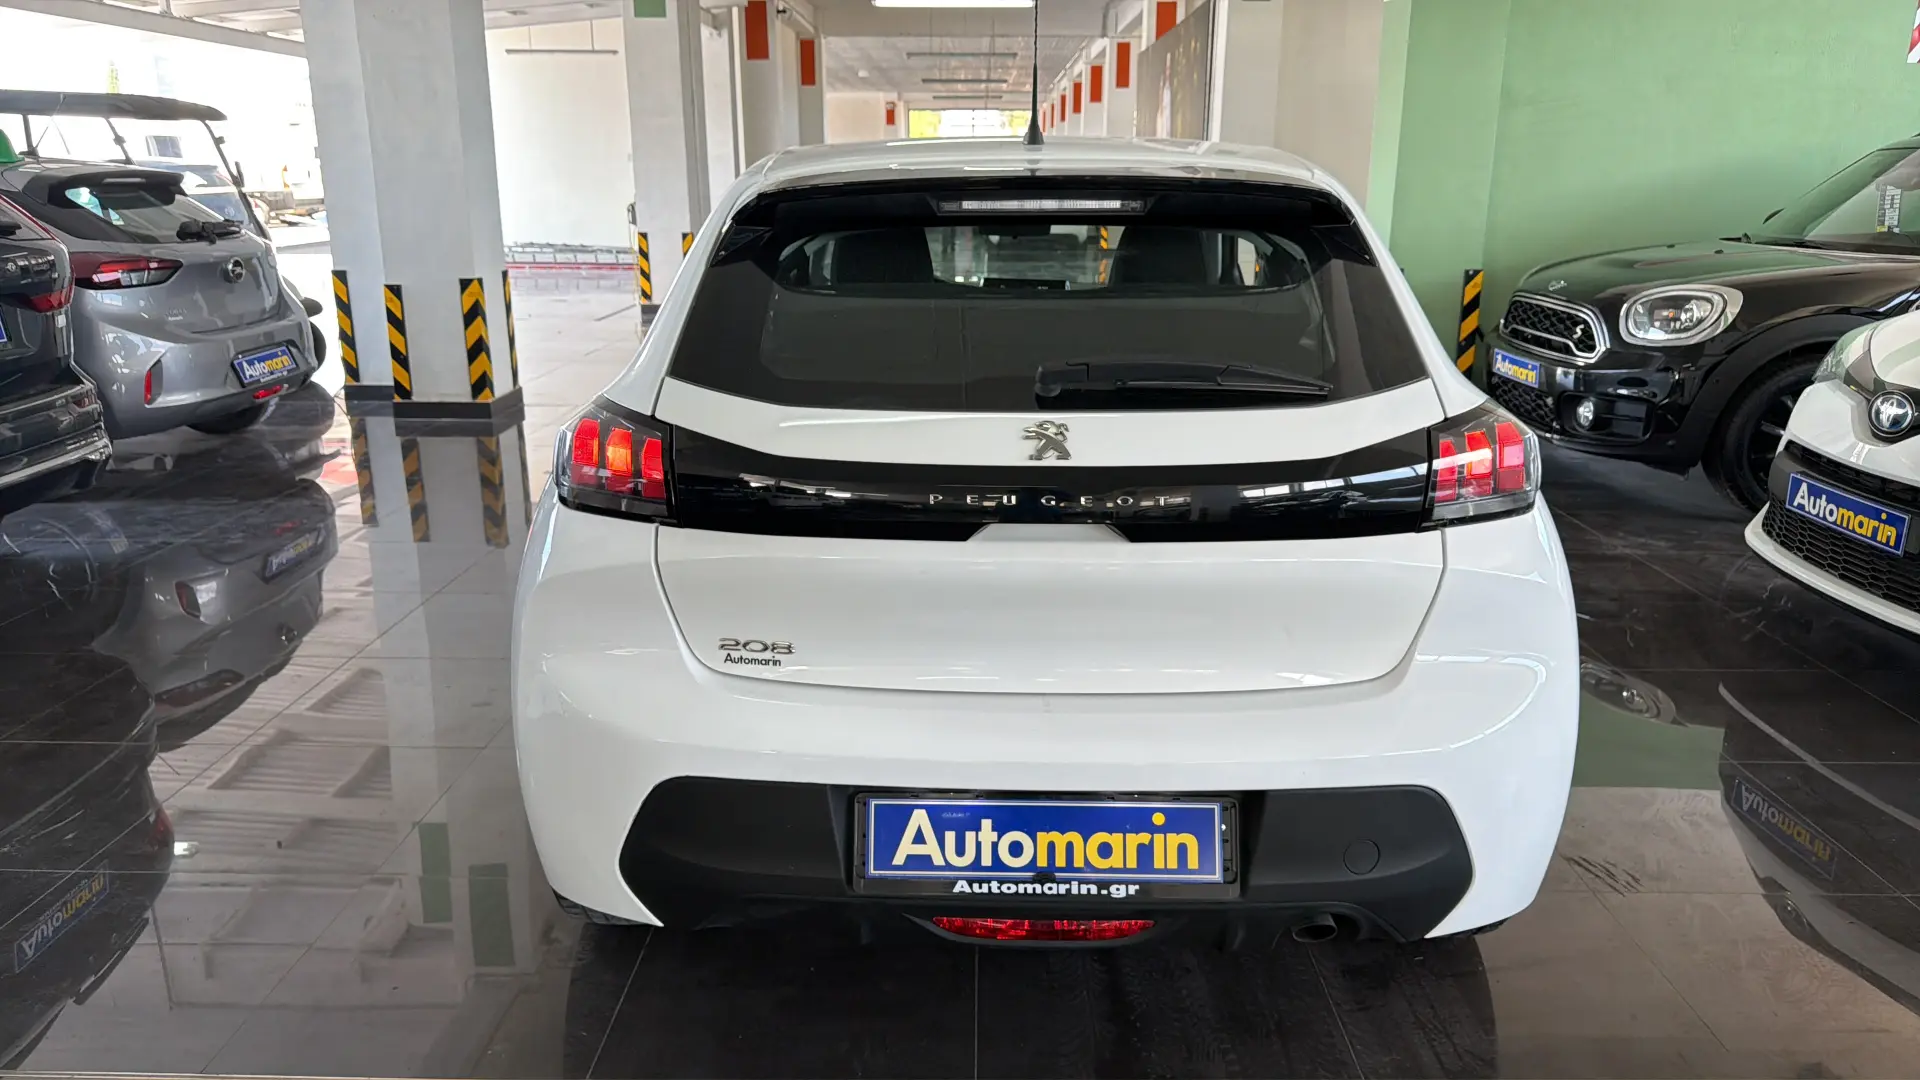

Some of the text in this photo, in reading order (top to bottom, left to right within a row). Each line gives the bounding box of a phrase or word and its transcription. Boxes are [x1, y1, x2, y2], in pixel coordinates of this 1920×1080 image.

[241, 351, 292, 379] Automarin
[1494, 353, 1537, 383] Automarin
[929, 493, 1170, 507] PEUGEOT
[1793, 482, 1897, 547] Automarin
[718, 637, 796, 654] 208
[723, 652, 782, 666] Automarin
[891, 808, 1199, 869] Automarin
[952, 879, 1140, 898] Automarin.gr
